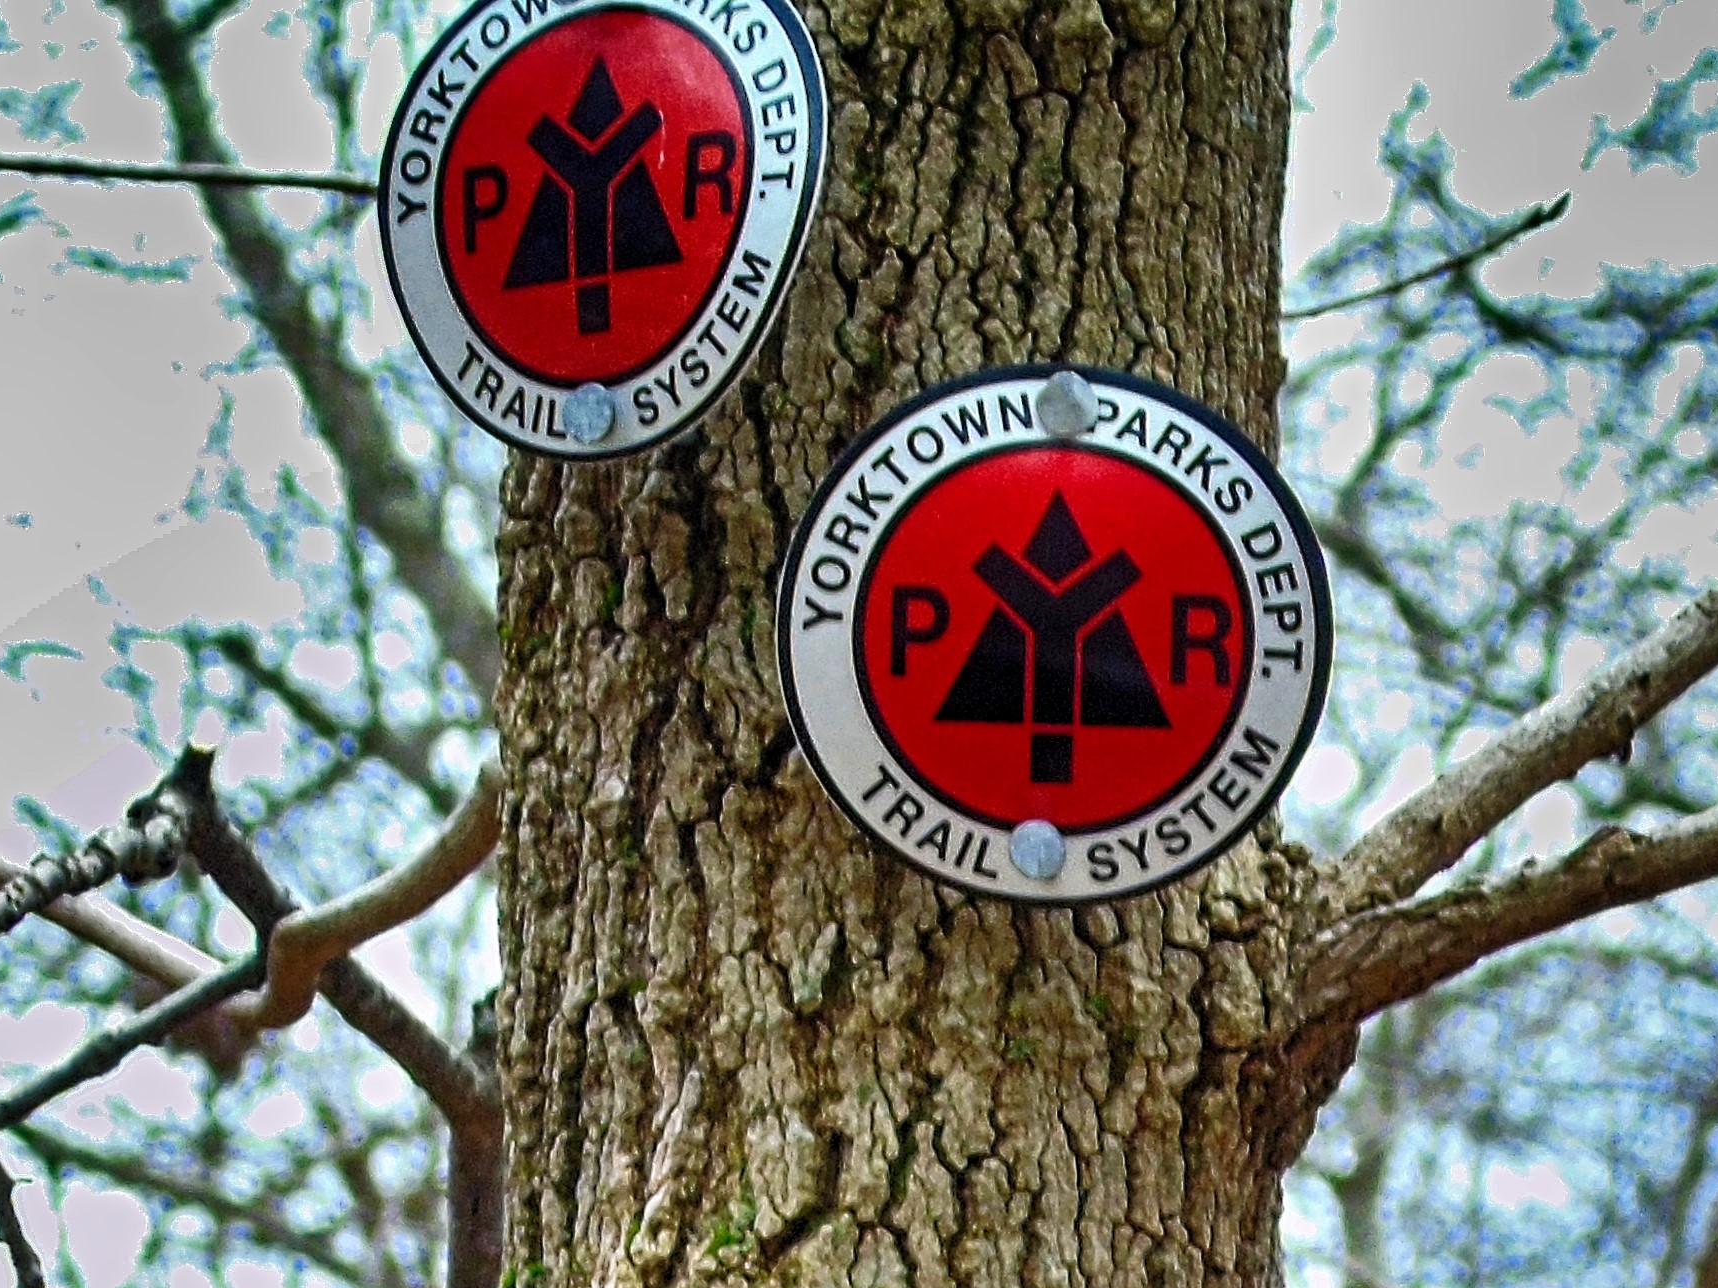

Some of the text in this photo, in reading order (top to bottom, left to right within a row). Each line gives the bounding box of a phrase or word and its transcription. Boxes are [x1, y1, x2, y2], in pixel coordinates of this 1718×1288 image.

[396, 0, 573, 225] YORKTOW
[752, 58, 797, 199] DEPT.
[462, 130, 739, 255] P R
[456, 250, 771, 439] TRAIL SYSTEM
[802, 393, 1303, 678] YORKTOWN PARKS DEPT.
[889, 586, 1231, 686] P R
[860, 727, 1281, 882] TRAIL SYSTEM
